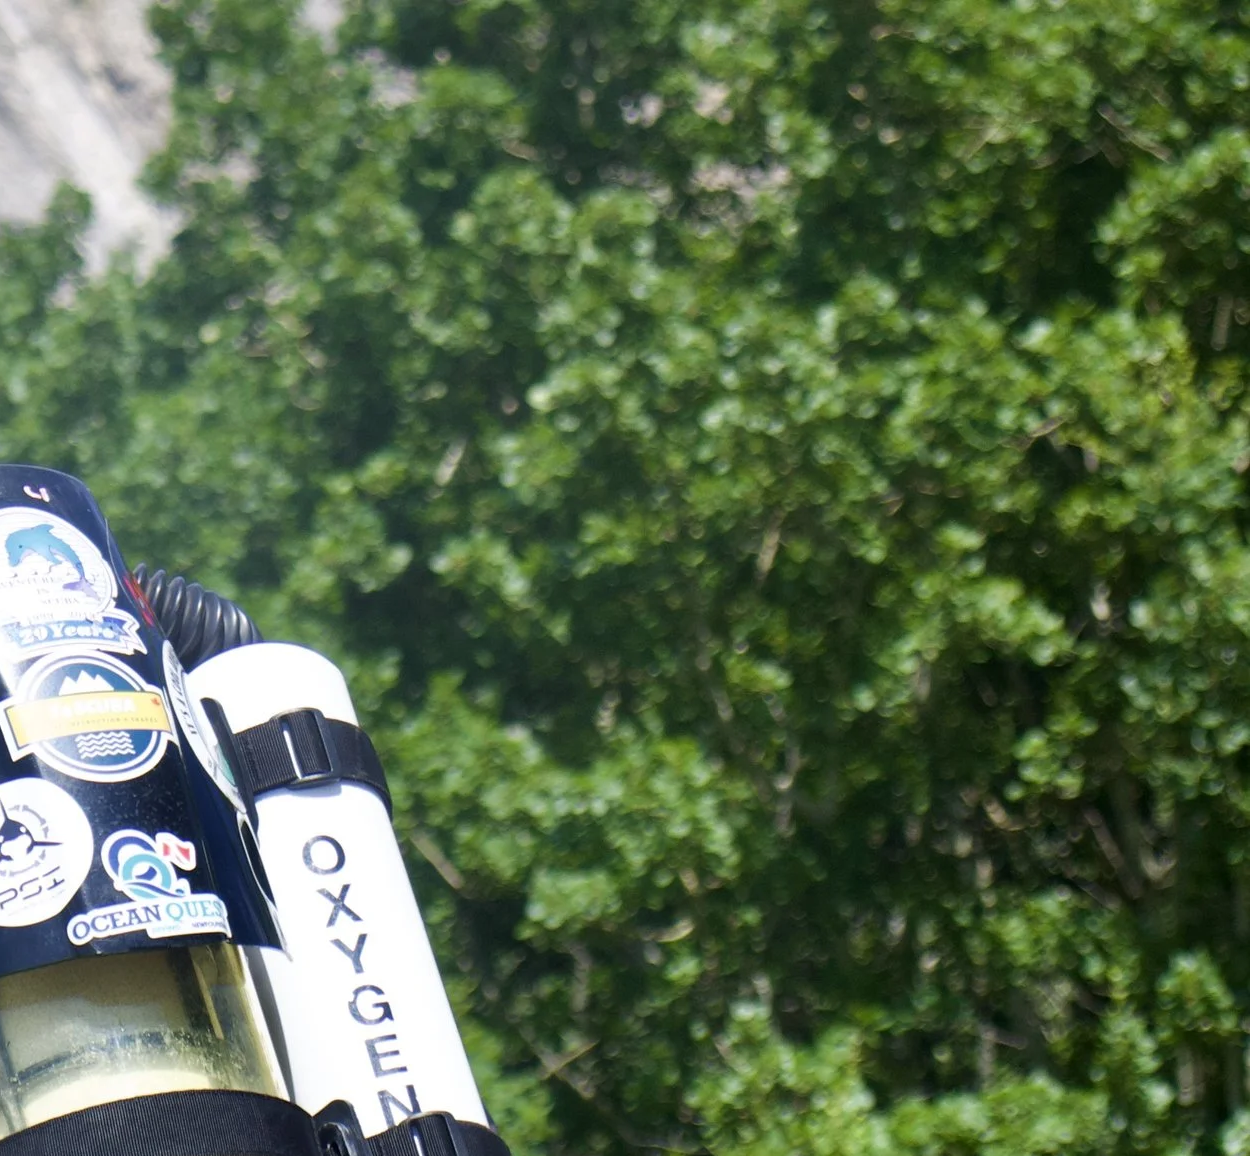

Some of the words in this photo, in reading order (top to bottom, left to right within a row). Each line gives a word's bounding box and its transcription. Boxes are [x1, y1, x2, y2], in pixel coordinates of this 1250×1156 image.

[18, 627, 49, 645] 20
[50, 622, 117, 641] Years
[71, 903, 163, 940] OCEAN
[165, 899, 225, 922] QUES
[302, 834, 423, 1130] OXYGEN
